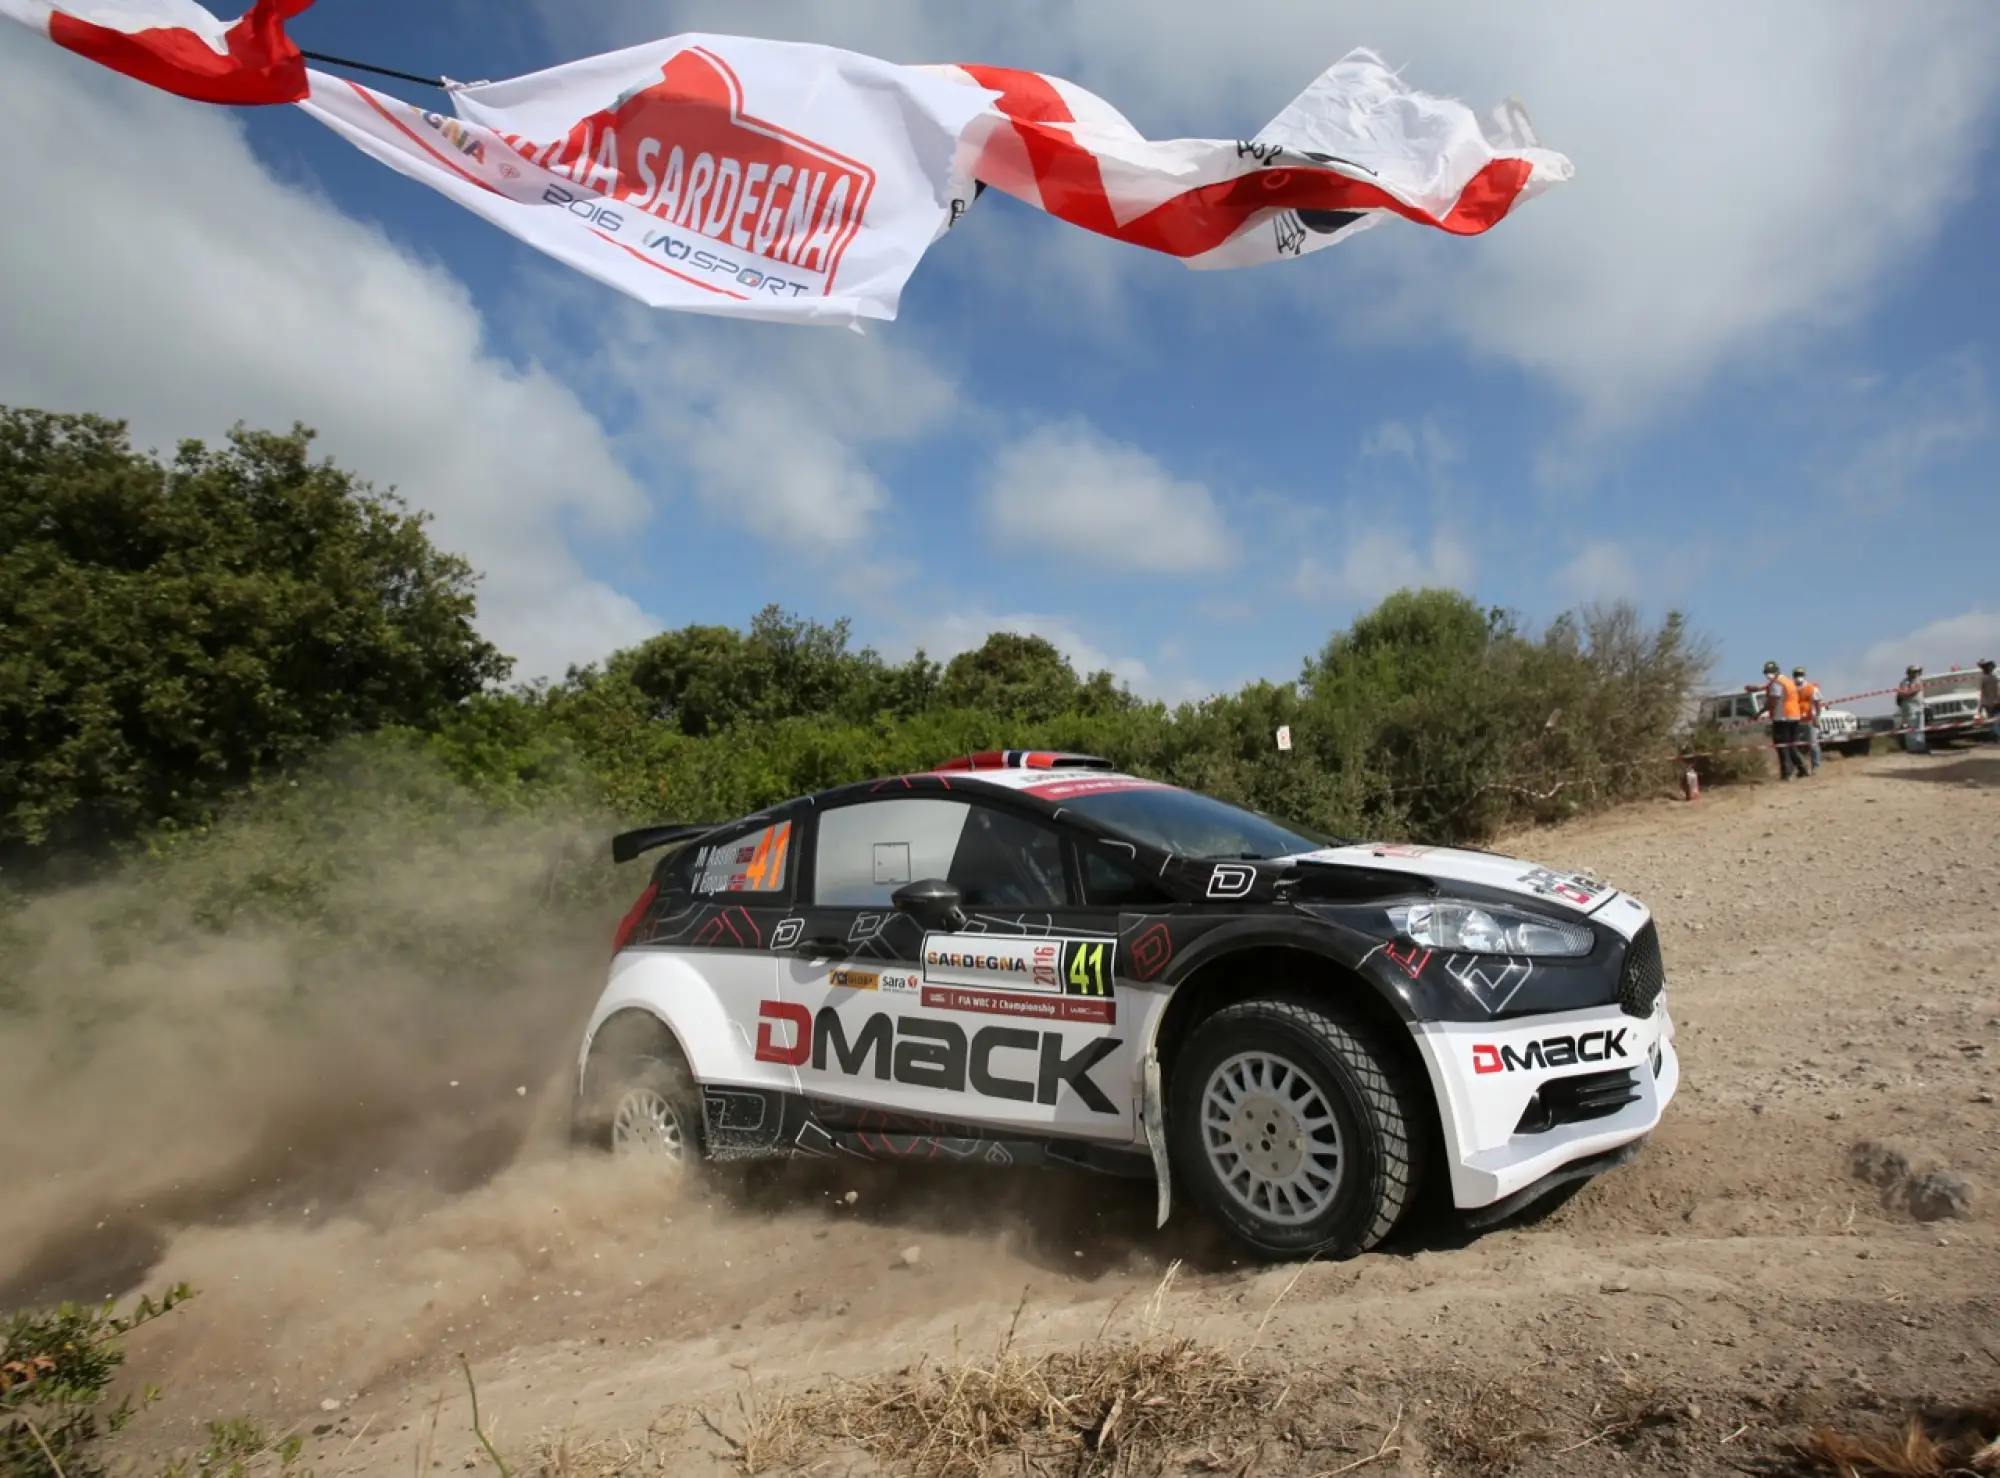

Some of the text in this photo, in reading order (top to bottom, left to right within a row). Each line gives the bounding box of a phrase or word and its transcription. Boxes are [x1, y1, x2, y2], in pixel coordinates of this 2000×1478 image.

[414, 106, 486, 165] GNA
[541, 183, 625, 232] 2016
[623, 137, 851, 272] SARDEGNA
[689, 251, 809, 297] SPORT
[746, 823, 792, 890] 41
[882, 975, 906, 988] sara
[927, 951, 1028, 973] SARDEGNA
[1032, 946, 1057, 987] 2016
[1069, 942, 1105, 996] 41
[958, 995, 972, 1005] FIA
[972, 996, 990, 1008] WRC
[991, 998, 997, 1009] 2
[999, 1000, 1056, 1015] Championship
